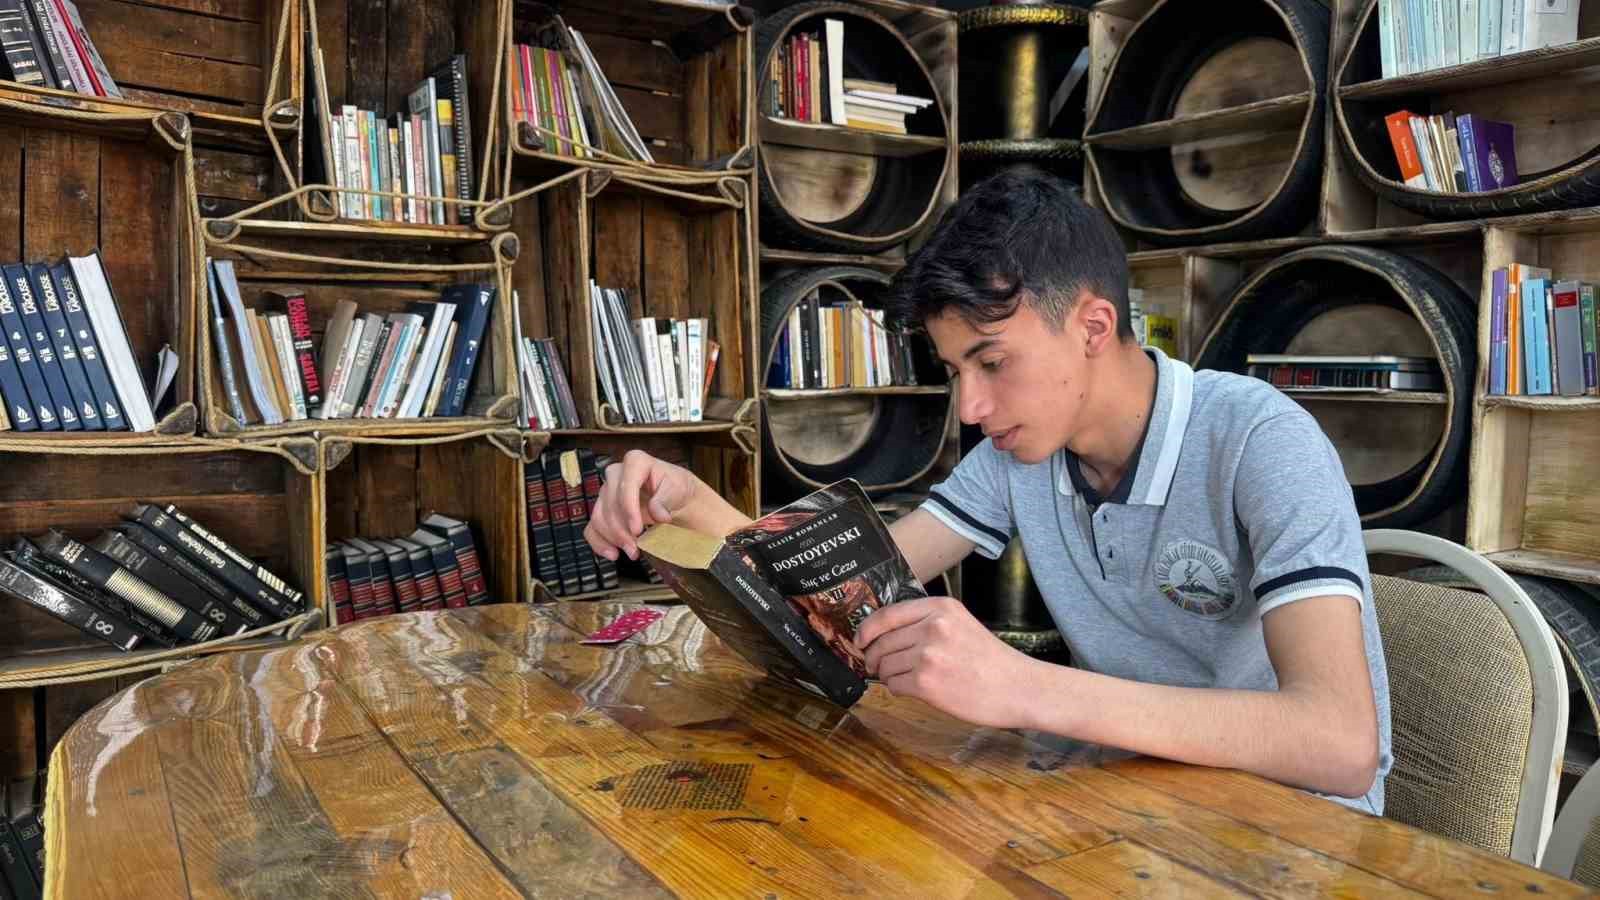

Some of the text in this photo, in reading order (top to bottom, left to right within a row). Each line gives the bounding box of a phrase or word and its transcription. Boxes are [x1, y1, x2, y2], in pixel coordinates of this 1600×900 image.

[16, 277, 37, 315] LAROUSSE
[40, 273, 60, 312] LAROUSSE
[62, 276, 81, 313] LAROUSSE
[12, 331, 21, 340] 4
[36, 331, 44, 341] 5
[57, 328, 65, 338] 7
[795, 513, 839, 537] ROMANLAR
[772, 526, 862, 573] DOSTOYEVSKI
[800, 559, 858, 589] Suç ve Ceza
